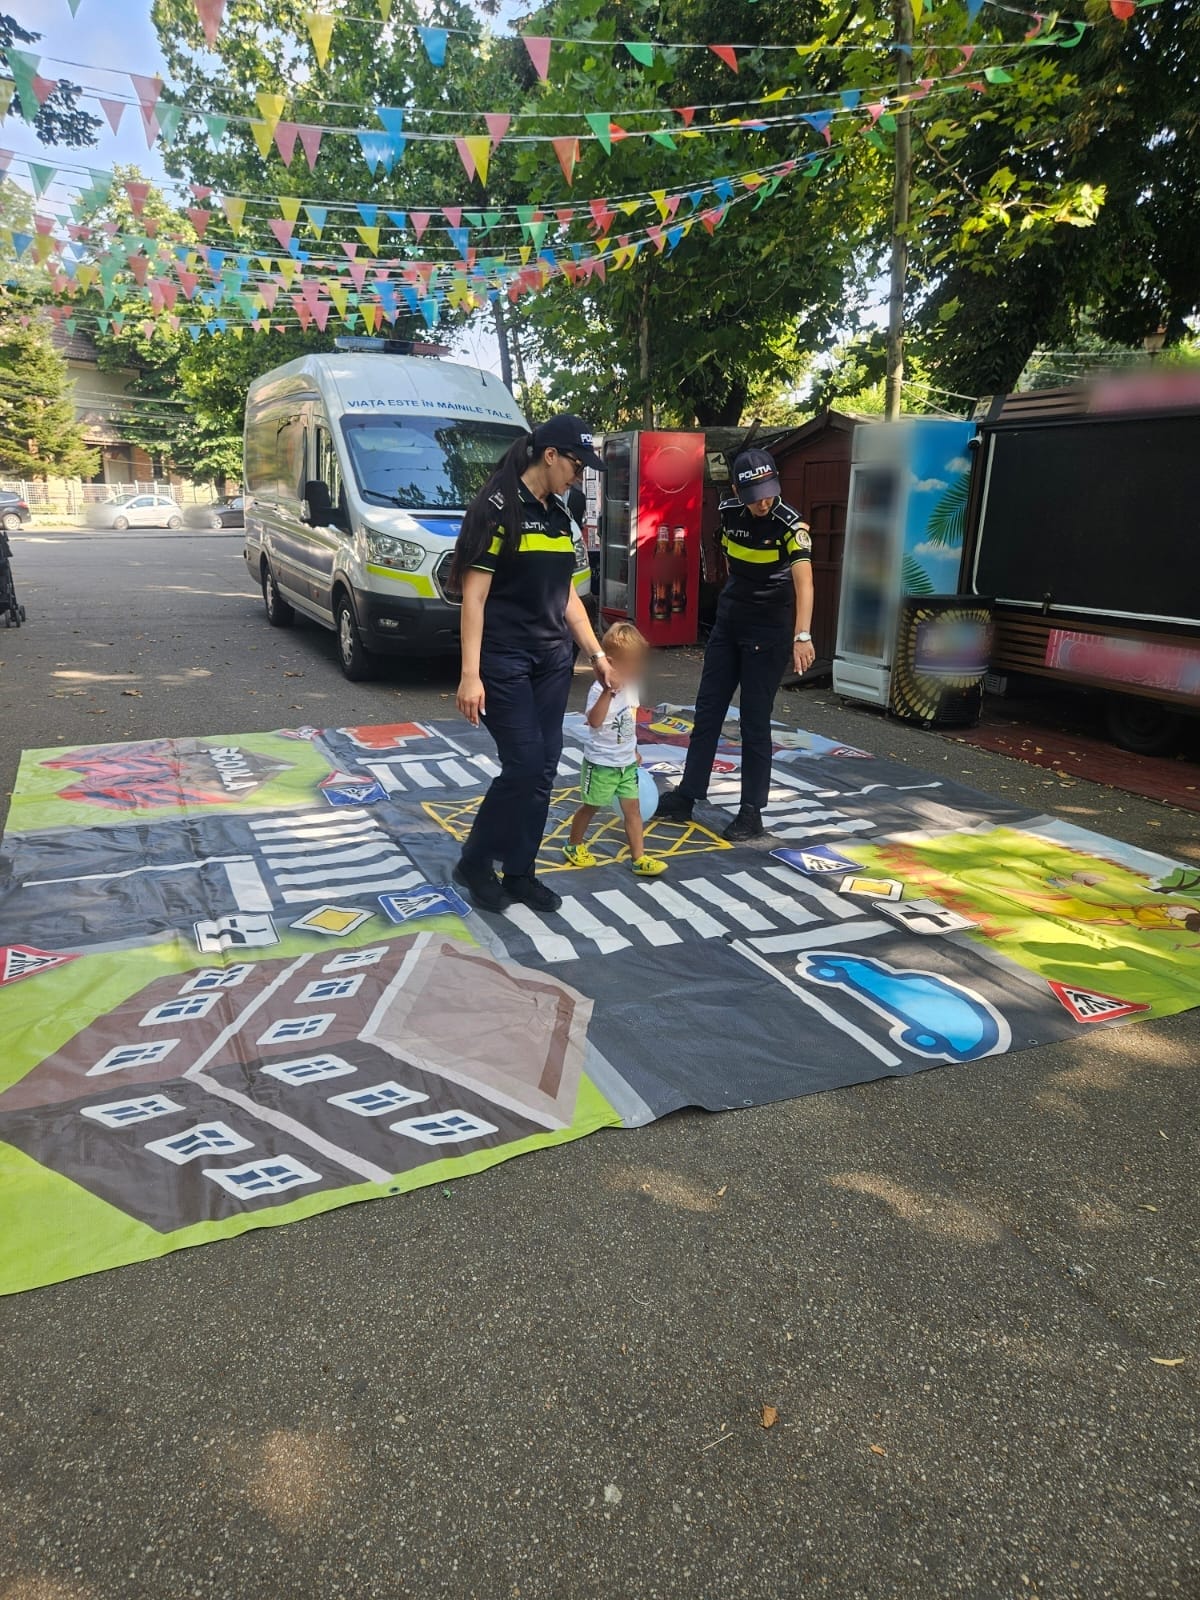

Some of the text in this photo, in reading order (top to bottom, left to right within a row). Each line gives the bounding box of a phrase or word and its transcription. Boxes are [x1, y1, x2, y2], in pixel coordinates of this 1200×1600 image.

[388, 399, 420, 407] ESTE
[421, 399, 435, 408] ÎN
[486, 408, 513, 420] TALE
